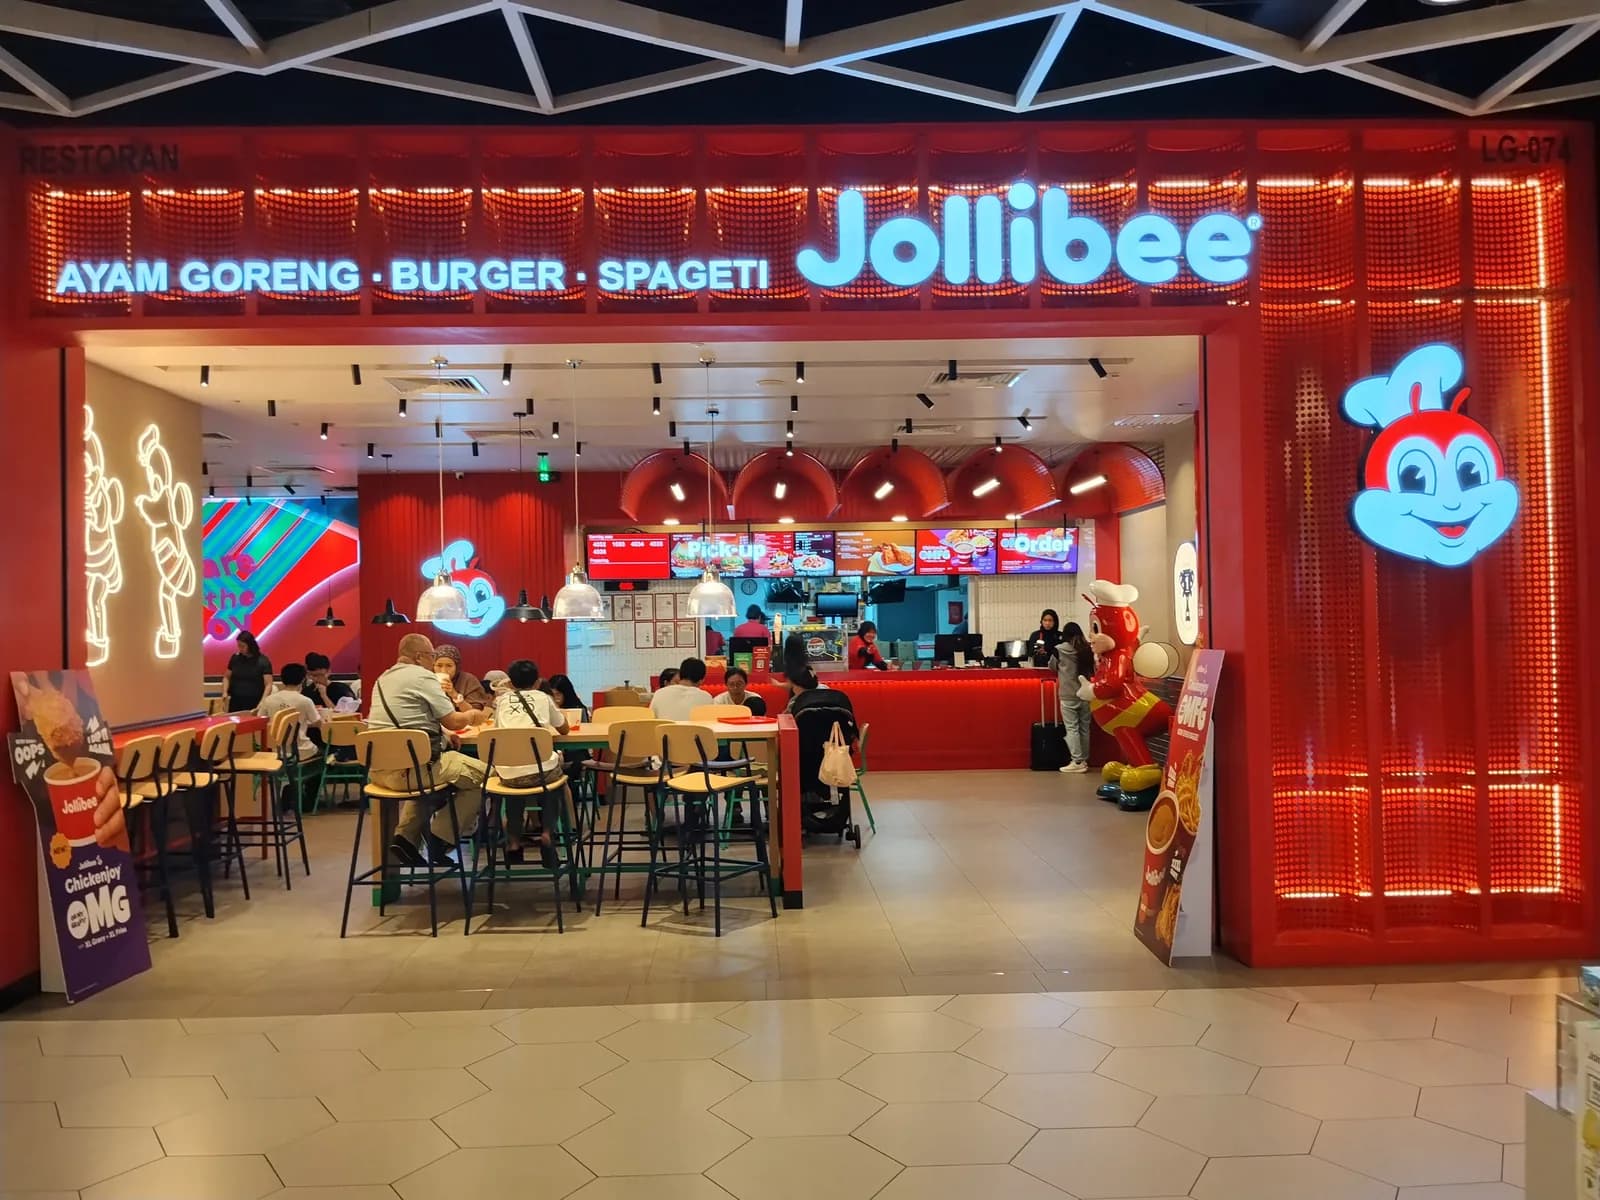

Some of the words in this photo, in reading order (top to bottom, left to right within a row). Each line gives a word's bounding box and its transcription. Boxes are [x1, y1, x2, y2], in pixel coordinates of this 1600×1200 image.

[19, 143, 179, 173] RESTORAN
[1481, 135, 1571, 163] LG-074
[796, 181, 1252, 287] Jollibee
[56, 261, 168, 293] AYAM
[179, 261, 361, 292] GORENG
[391, 260, 566, 291] BURGER
[598, 259, 769, 290] SPAGETI
[687, 540, 767, 561] Pick-up
[1014, 533, 1074, 553] Order
[14, 743, 46, 765] OOPS
[62, 796, 98, 815] Jollibee
[64, 865, 122, 894] Chickenjoy
[66, 884, 132, 940] OMG
